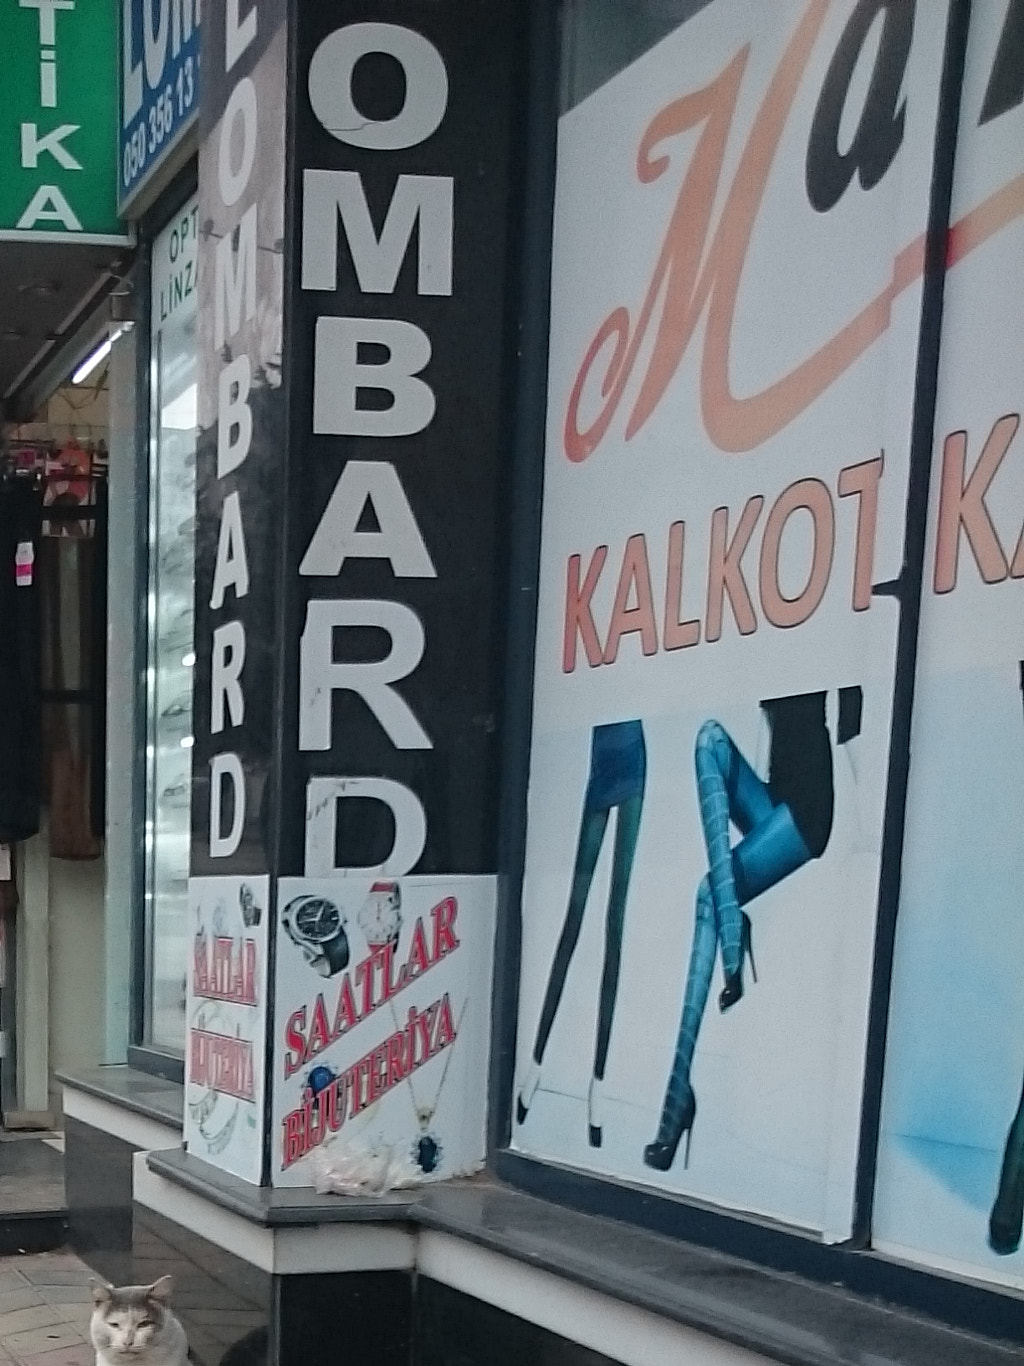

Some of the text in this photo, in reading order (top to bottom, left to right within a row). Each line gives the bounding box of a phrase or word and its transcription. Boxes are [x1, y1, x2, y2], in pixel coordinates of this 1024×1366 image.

[148, 83, 173, 154] 356
[283, 895, 461, 1081] SAATLAR
[281, 992, 458, 1172] BİJUTERİYA
